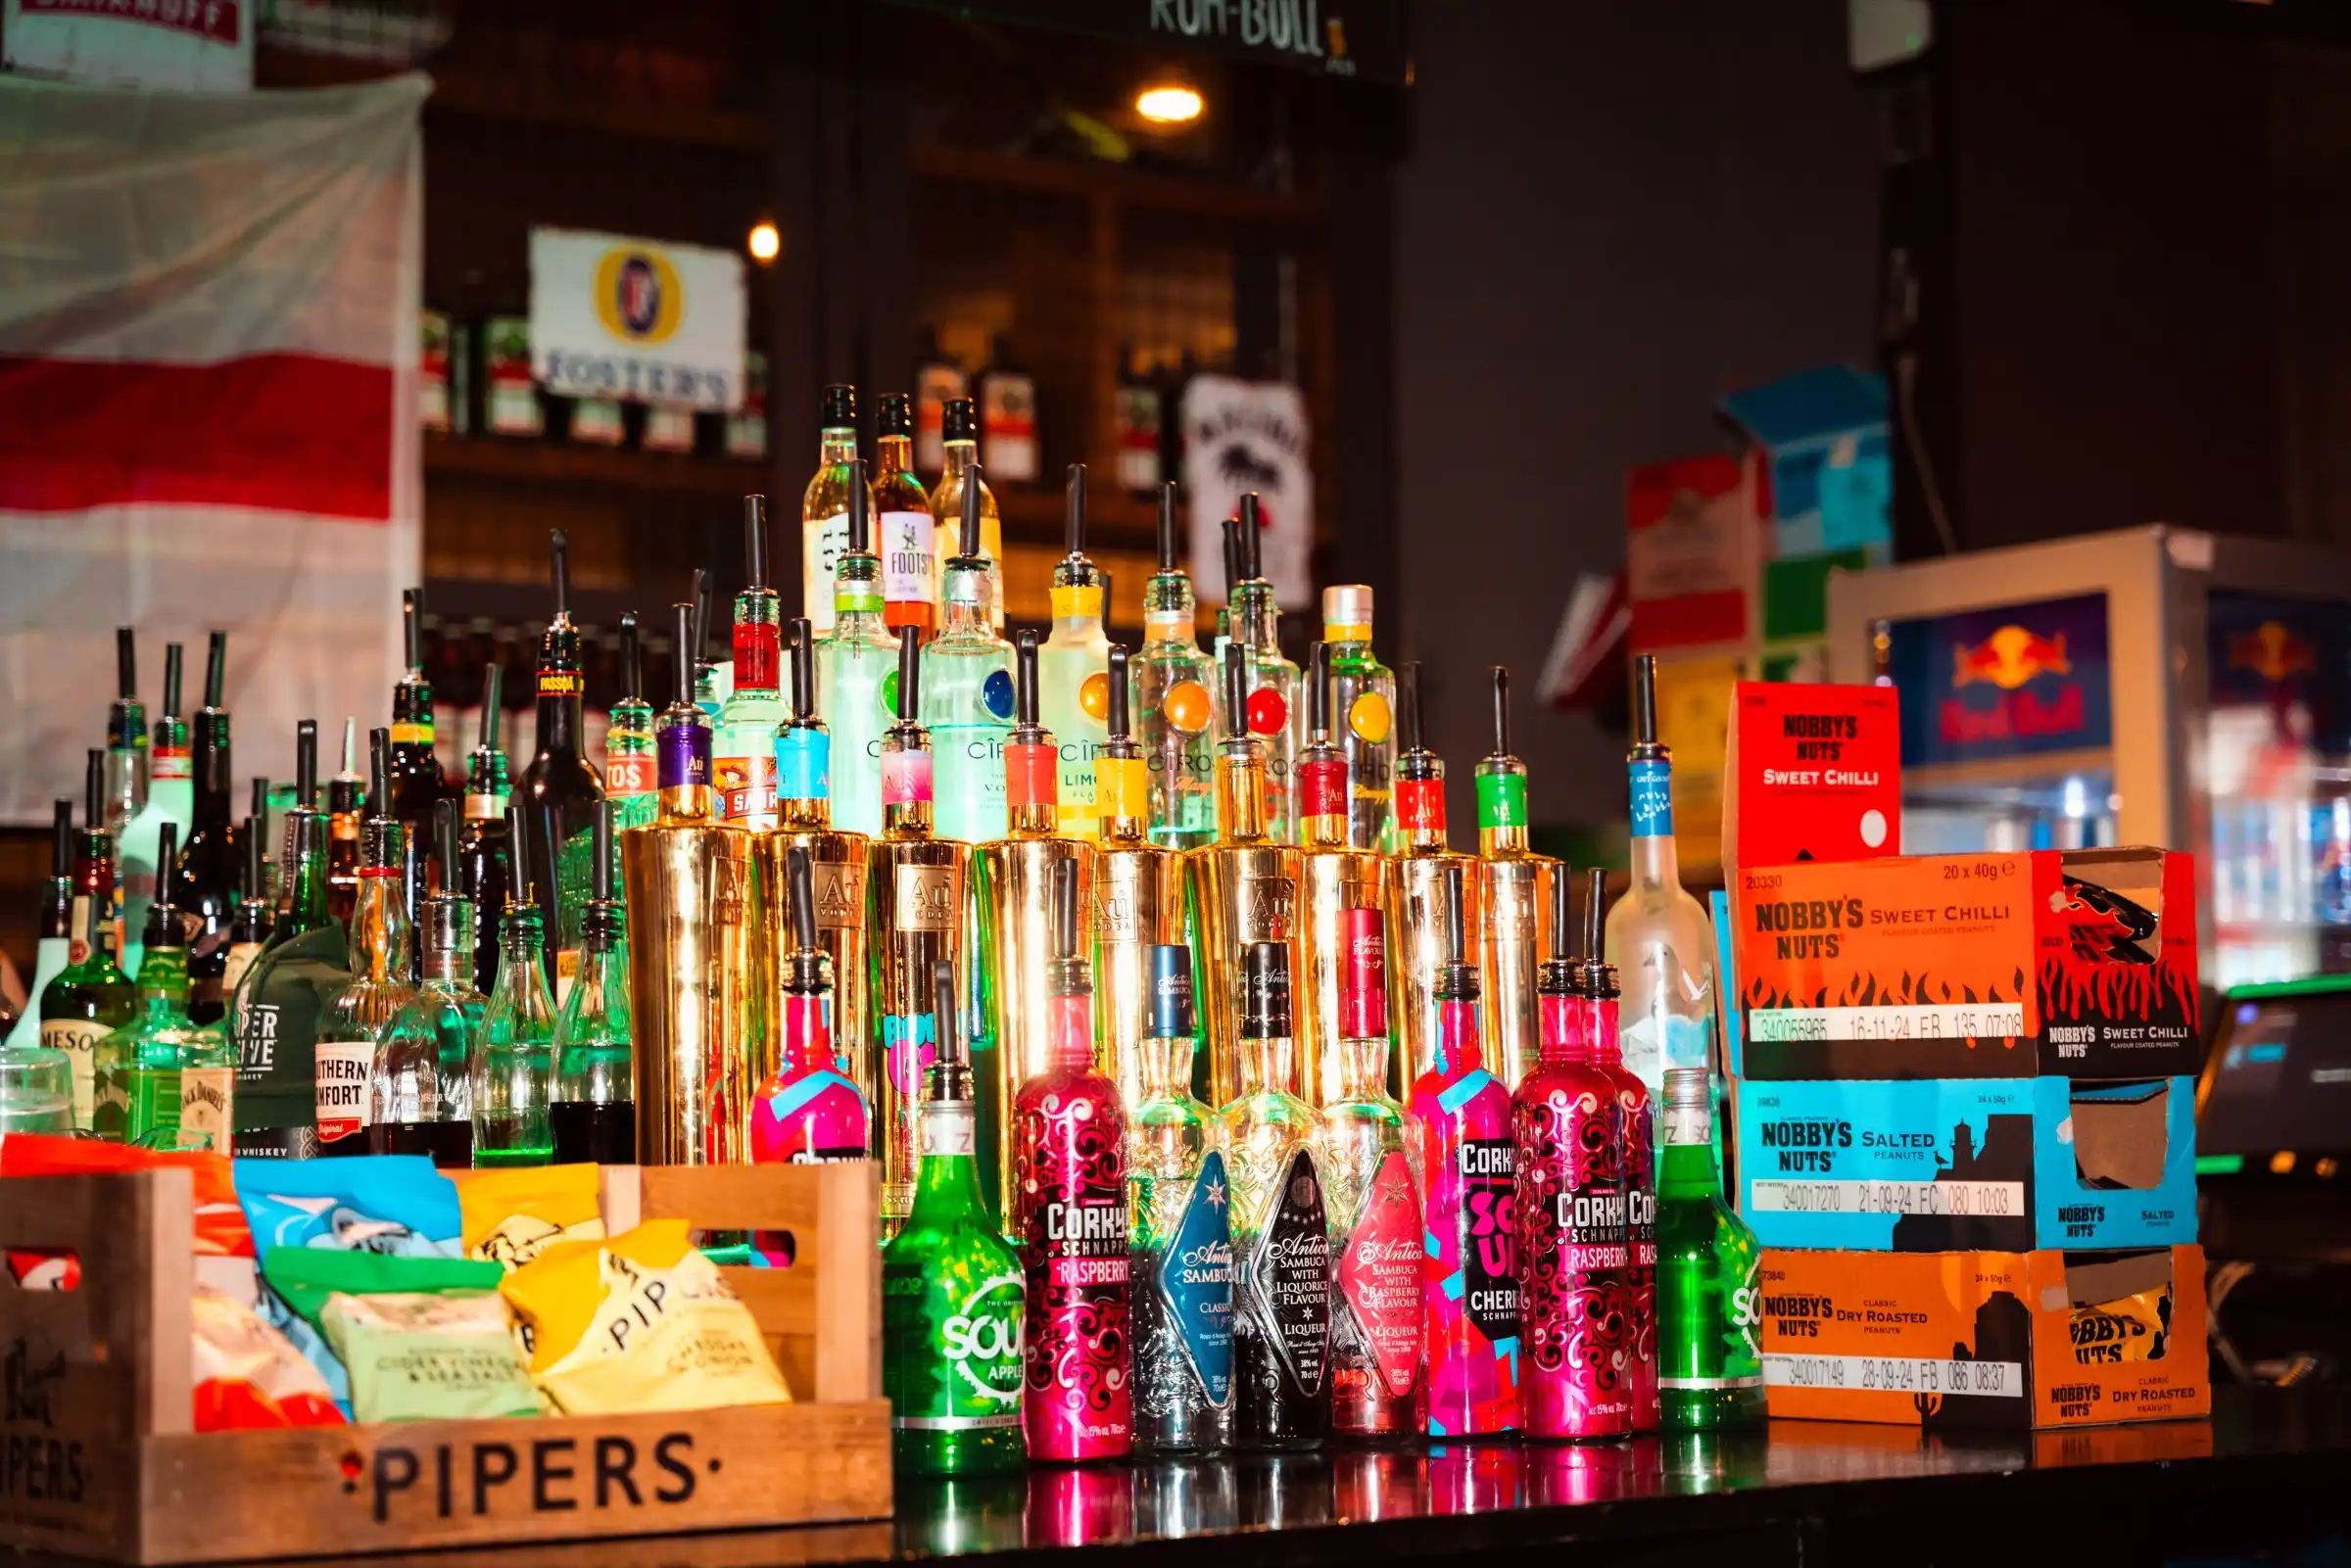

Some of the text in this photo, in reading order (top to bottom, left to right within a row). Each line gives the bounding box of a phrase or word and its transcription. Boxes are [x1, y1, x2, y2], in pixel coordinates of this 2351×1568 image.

[1784, 714, 1858, 738] NOBBY'S
[1797, 741, 1841, 761] NUTS
[1763, 769, 1880, 786] SWEET CHILLI
[1943, 862, 1997, 881] 20 x 40g
[1746, 875, 1783, 889] 20330
[1755, 893, 1864, 932] NOBBY'S
[1870, 904, 2010, 925] SWEET CHILLI
[1776, 933, 1840, 960] NUTS
[1850, 1016, 1910, 1040] 16-11-24
[1954, 1013, 1977, 1038] 135
[1985, 1012, 2023, 1037] 07:08
[2103, 1025, 2188, 1039] SWEET CHILLI
[2049, 1024, 2096, 1044] NOBBY'S
[2058, 1043, 2087, 1058] NUTS
[1761, 1117, 1852, 1148] NOBBY'S
[1862, 1131, 1935, 1149] SALTED
[242, 1148, 288, 1157] WHISKEY
[1874, 1151, 1925, 1161] PEANUTS
[1779, 1151, 1832, 1172] NUTS
[1782, 1185, 2009, 1214] 340017270 21-09-24 FC 080 10:03
[2058, 1205, 2105, 1222] NOBBY'S
[2067, 1224, 2094, 1237] NUTS
[1375, 1238, 1423, 1261] Antica
[1280, 1257, 1325, 1268] SAMBUCA
[1372, 1263, 1417, 1275] SAMBUCA
[1291, 1269, 1319, 1280] WITH
[1384, 1276, 1412, 1286] WITH
[1276, 1281, 1328, 1294] LIQUORICE
[1368, 1286, 1420, 1298] RASPBERRY
[1283, 1293, 1326, 1306] FLAVOUR
[1375, 1298, 1418, 1309] FLAVOUR
[1764, 1295, 1833, 1318] NOBBY'S
[1836, 1309, 1928, 1324] DRY ROASTED
[1284, 1323, 1326, 1336] LIQUEUR
[1374, 1326, 1418, 1339] LIQUEUR
[1778, 1320, 1819, 1337] NUTS
[1864, 1326, 1901, 1335] PEANUTS
[1300, 1359, 1312, 1368] 38%
[1789, 1359, 1845, 1387] 340017149
[1862, 1359, 1914, 1390] 28-09-24
[1920, 1361, 1939, 1391] FB
[1975, 1363, 2005, 1391] 08:37
[2051, 1382, 2101, 1403] NOBBY'S
[2112, 1387, 2196, 1402] DRY ROASTED
[2060, 1403, 2089, 1418] NUTS
